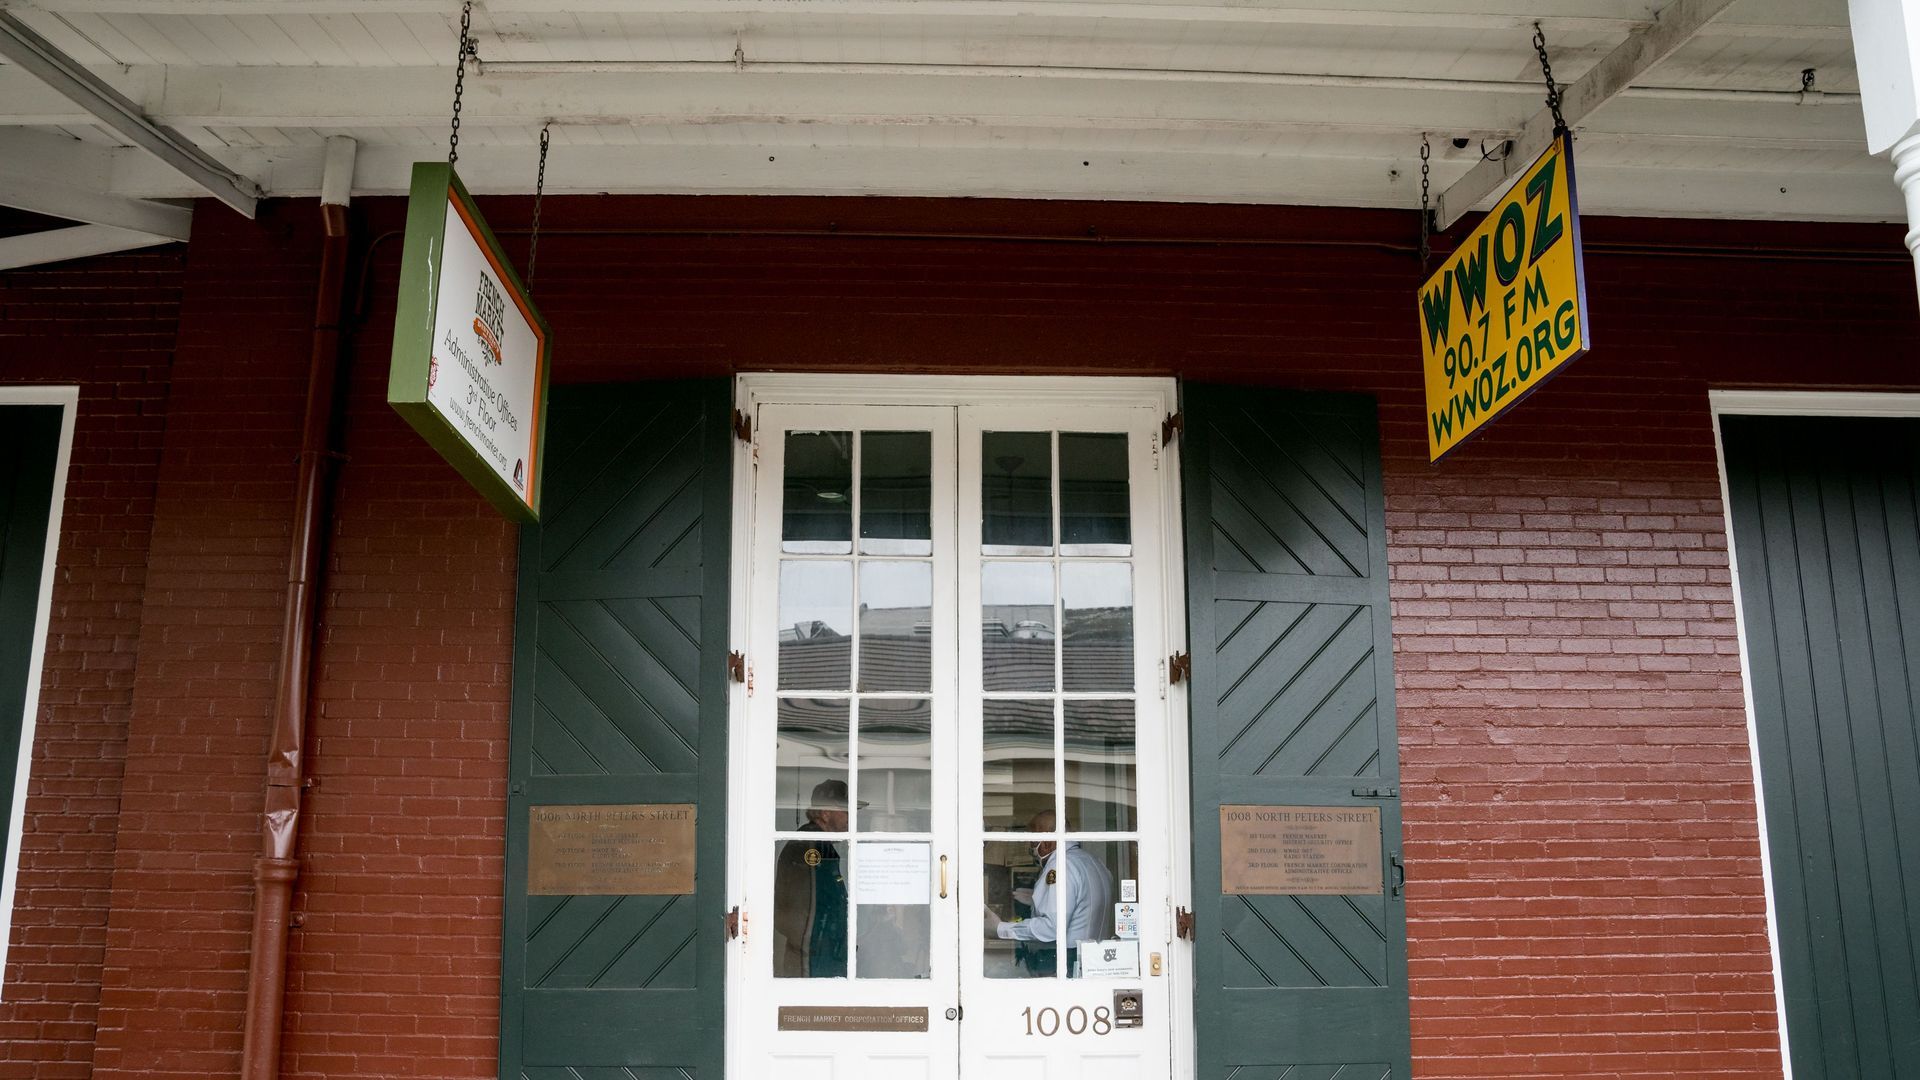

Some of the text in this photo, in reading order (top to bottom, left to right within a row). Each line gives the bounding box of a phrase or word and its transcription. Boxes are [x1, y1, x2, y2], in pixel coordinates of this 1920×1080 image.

[1422, 155, 1563, 355] WWOZ
[475, 292, 504, 349] MARKET
[479, 270, 505, 325] FRENCH
[1443, 265, 1549, 389] 90.7 FM
[444, 328, 518, 432] Administrative Offices
[1432, 299, 1575, 448] WWOZ.ORG
[449, 397, 508, 471] www.frenchmarket.org
[477, 397, 497, 432] Floor
[606, 811, 645, 821] PETERS
[650, 810, 689, 820] STREET
[1227, 812, 1374, 823] 1008 NORTH PETERS STREET
[1117, 924, 1137, 932] HERE
[783, 1015, 811, 1023] FRENCH
[813, 1015, 841, 1023] MARKET
[895, 1015, 924, 1024] OFFICES
[1021, 1005, 1112, 1036] 1008
